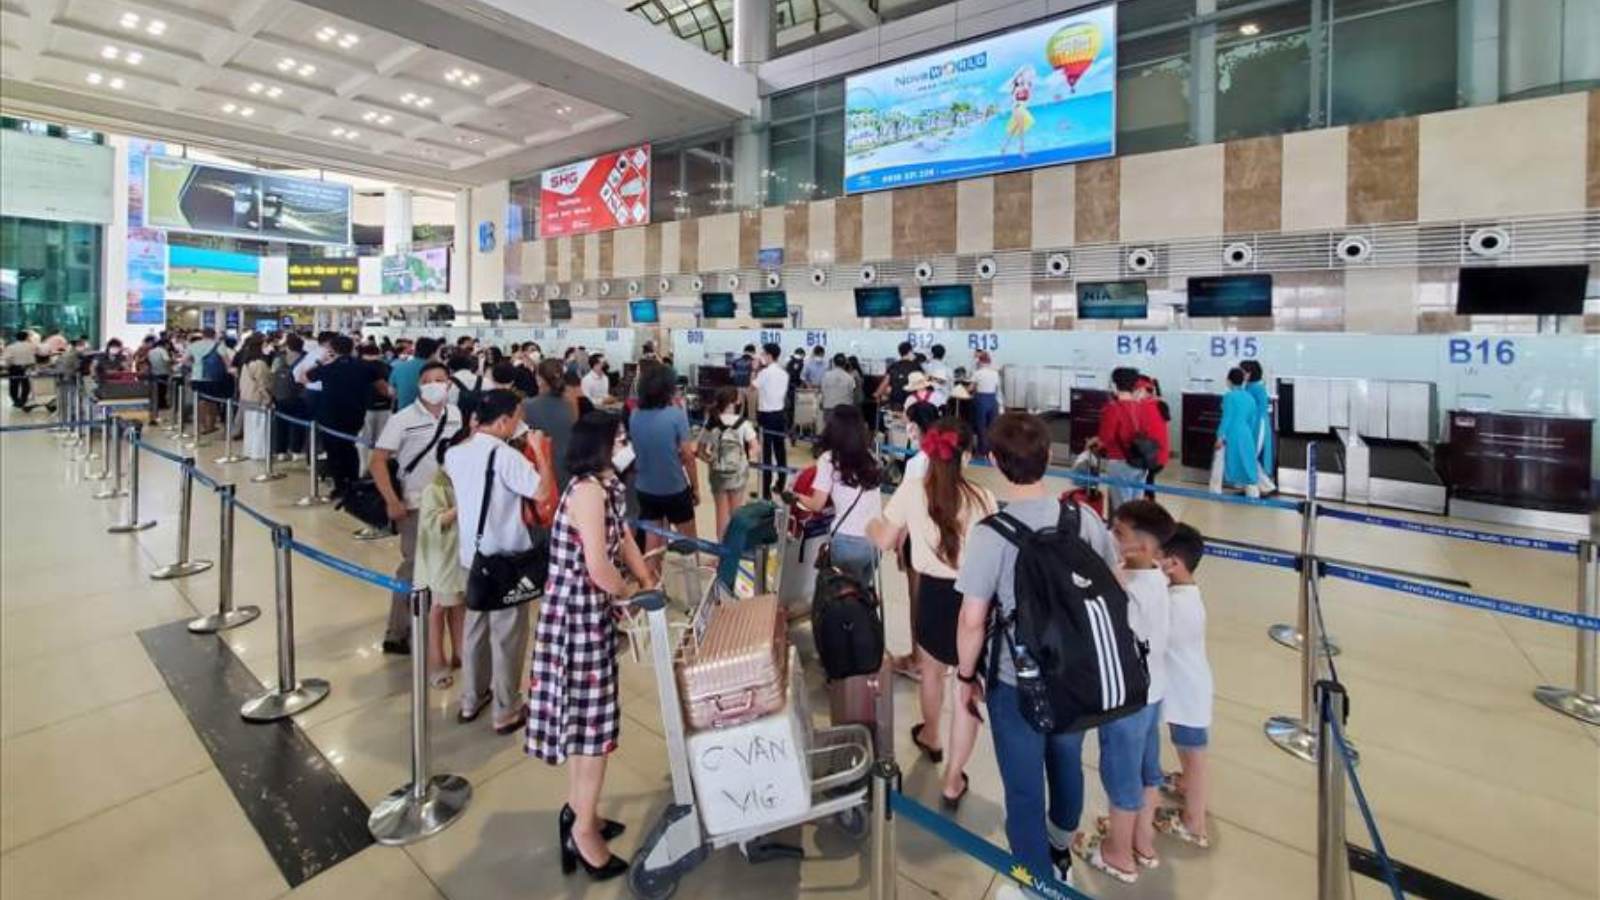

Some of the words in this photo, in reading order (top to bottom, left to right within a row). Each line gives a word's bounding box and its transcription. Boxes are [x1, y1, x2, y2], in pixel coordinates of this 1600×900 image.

[760, 331, 781, 345] B10
[806, 332, 827, 346] B11
[907, 332, 935, 350] B12
[968, 333, 999, 351] B13
[1117, 335, 1158, 355] B14
[1210, 336, 1257, 357] B15
[1449, 339, 1515, 365] B16
[702, 745, 725, 772] C
